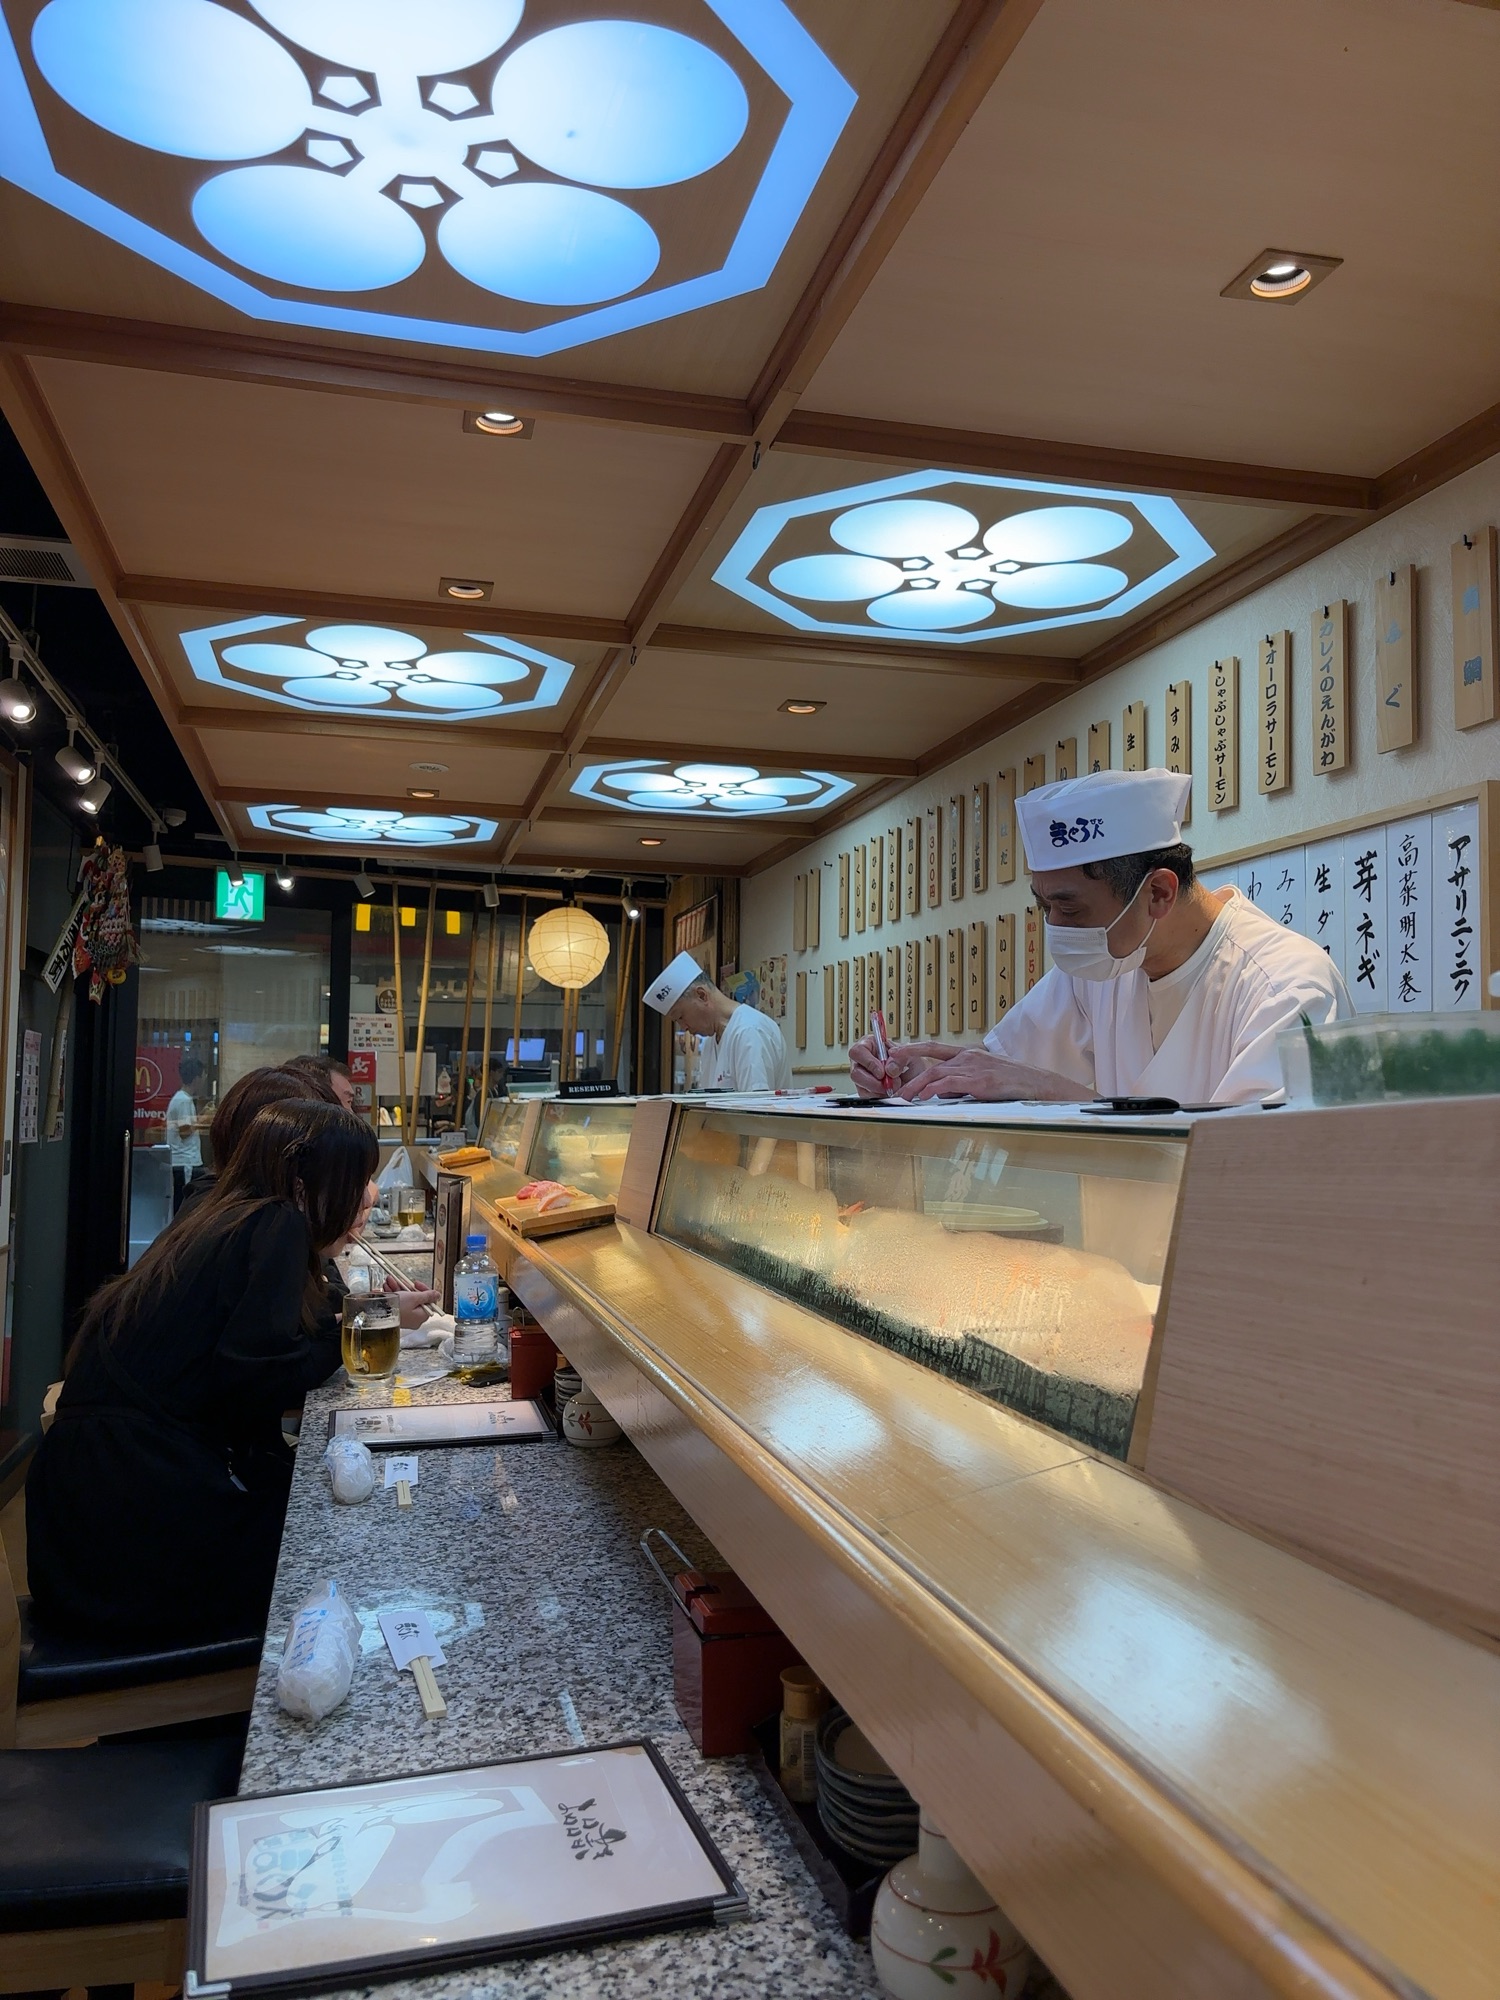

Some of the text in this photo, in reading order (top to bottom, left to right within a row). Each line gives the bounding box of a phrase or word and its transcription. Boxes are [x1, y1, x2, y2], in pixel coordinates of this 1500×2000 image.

[1214, 675, 1227, 805] しゃぶしゃぶサーモン
[1264, 648, 1278, 787] オーロラサーモン
[1318, 620, 1336, 767] カレイのえんがわ
[999, 939, 1007, 1009] いくら
[1314, 863, 1334, 955] 生ダ
[1352, 850, 1380, 990] 芽ネギ
[1397, 834, 1422, 1003] 高菜明太巻
[1447, 834, 1474, 1005] アサリニンニク
[568, 1084, 612, 1093] RESERVED
